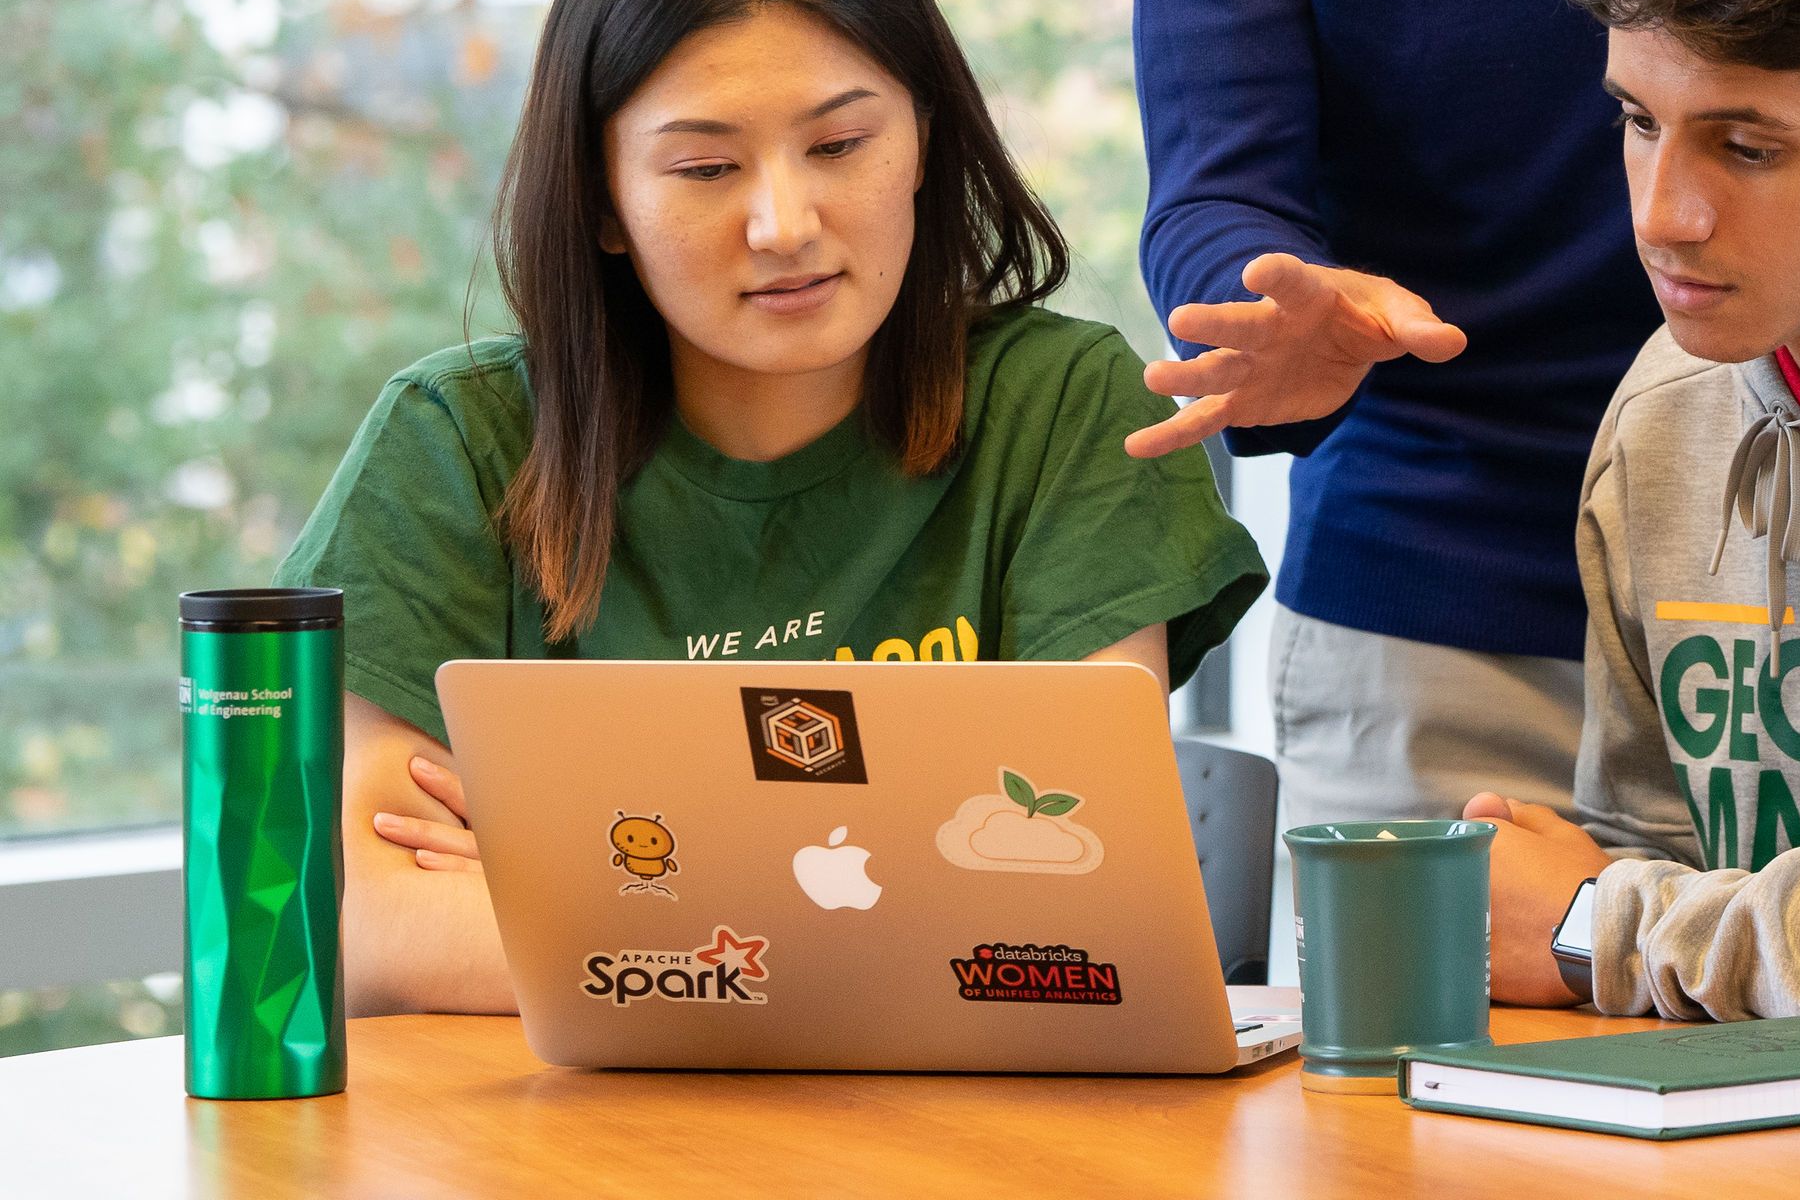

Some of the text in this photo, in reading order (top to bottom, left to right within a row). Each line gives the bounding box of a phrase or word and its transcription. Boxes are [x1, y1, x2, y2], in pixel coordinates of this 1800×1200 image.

[687, 631, 741, 659] WE
[755, 611, 825, 650] ARE
[198, 689, 248, 702] Volgenau
[251, 687, 292, 700] School
[210, 704, 282, 719] Engineering
[620, 953, 692, 965] APACHE
[994, 947, 1083, 962] databricks
[584, 956, 752, 1004] Spark
[956, 962, 1115, 990] WOMEN
[964, 988, 1117, 1001] OF UNIFIED ANALYTICS
